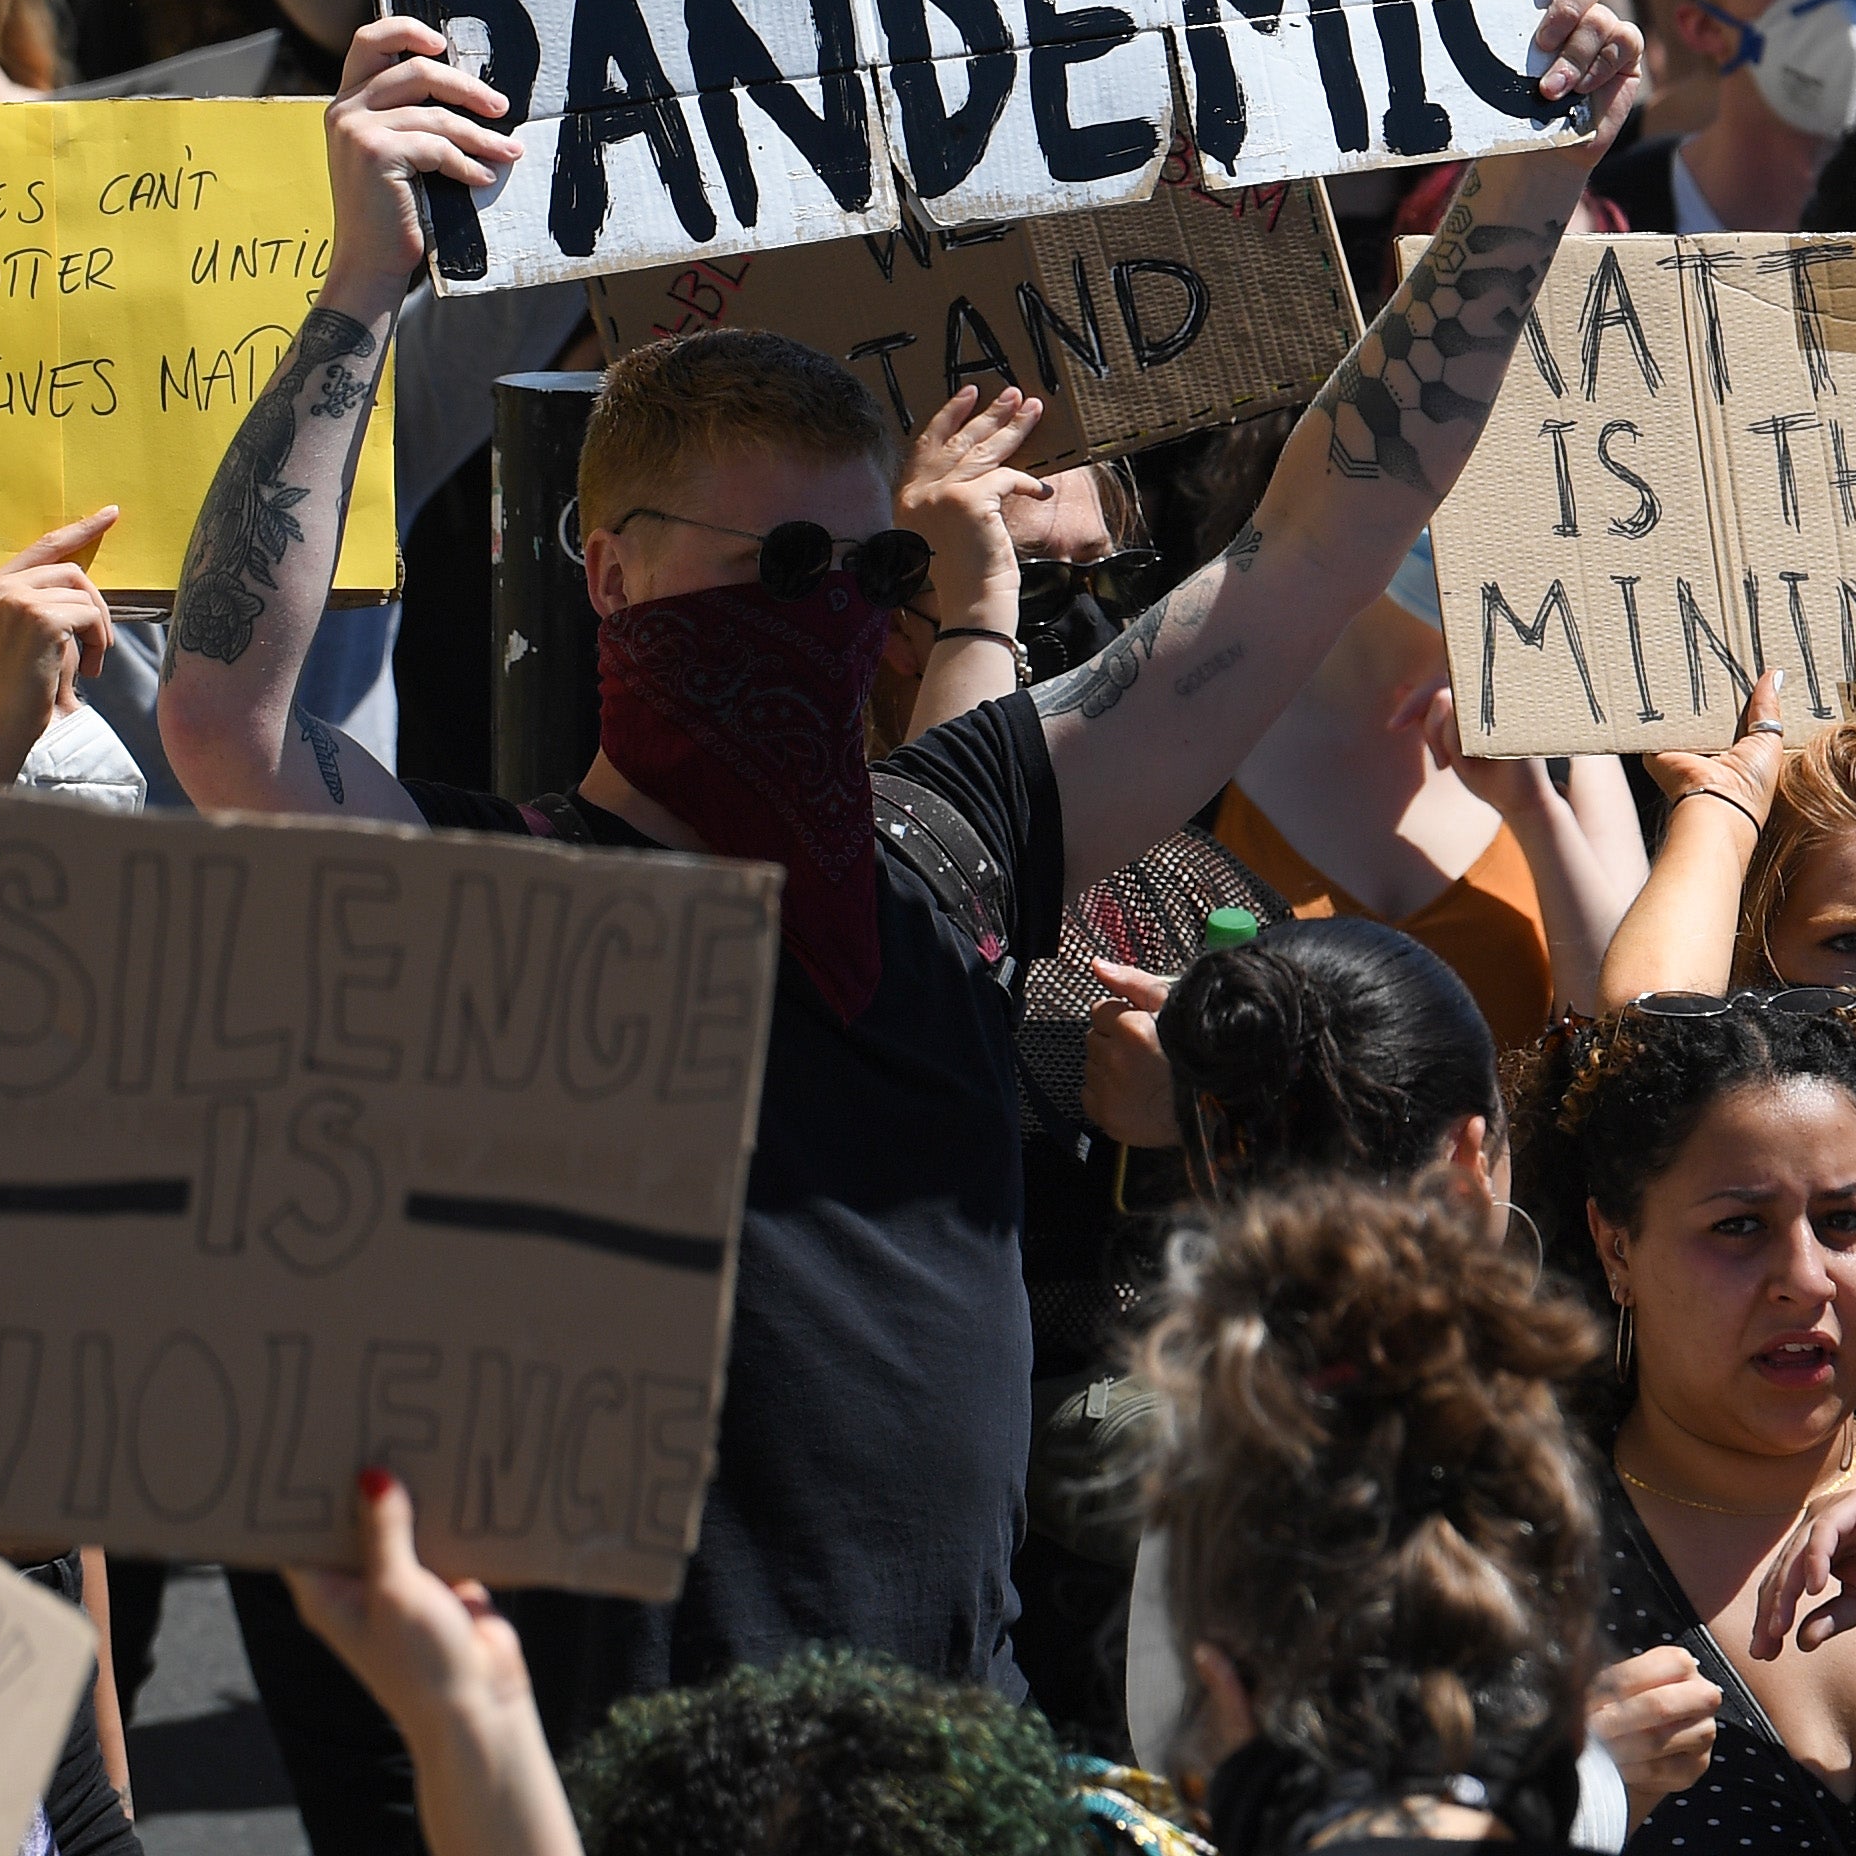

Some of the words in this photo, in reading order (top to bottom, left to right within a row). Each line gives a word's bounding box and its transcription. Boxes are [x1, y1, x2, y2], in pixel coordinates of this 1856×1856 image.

[98, 144, 221, 218] CAN'T
[191, 227, 332, 286] UNTIL
[159, 322, 304, 415] MATT
[846, 252, 1212, 437] TAND
[1538, 418, 1664, 538] IS
[195, 1088, 386, 1278] IS
